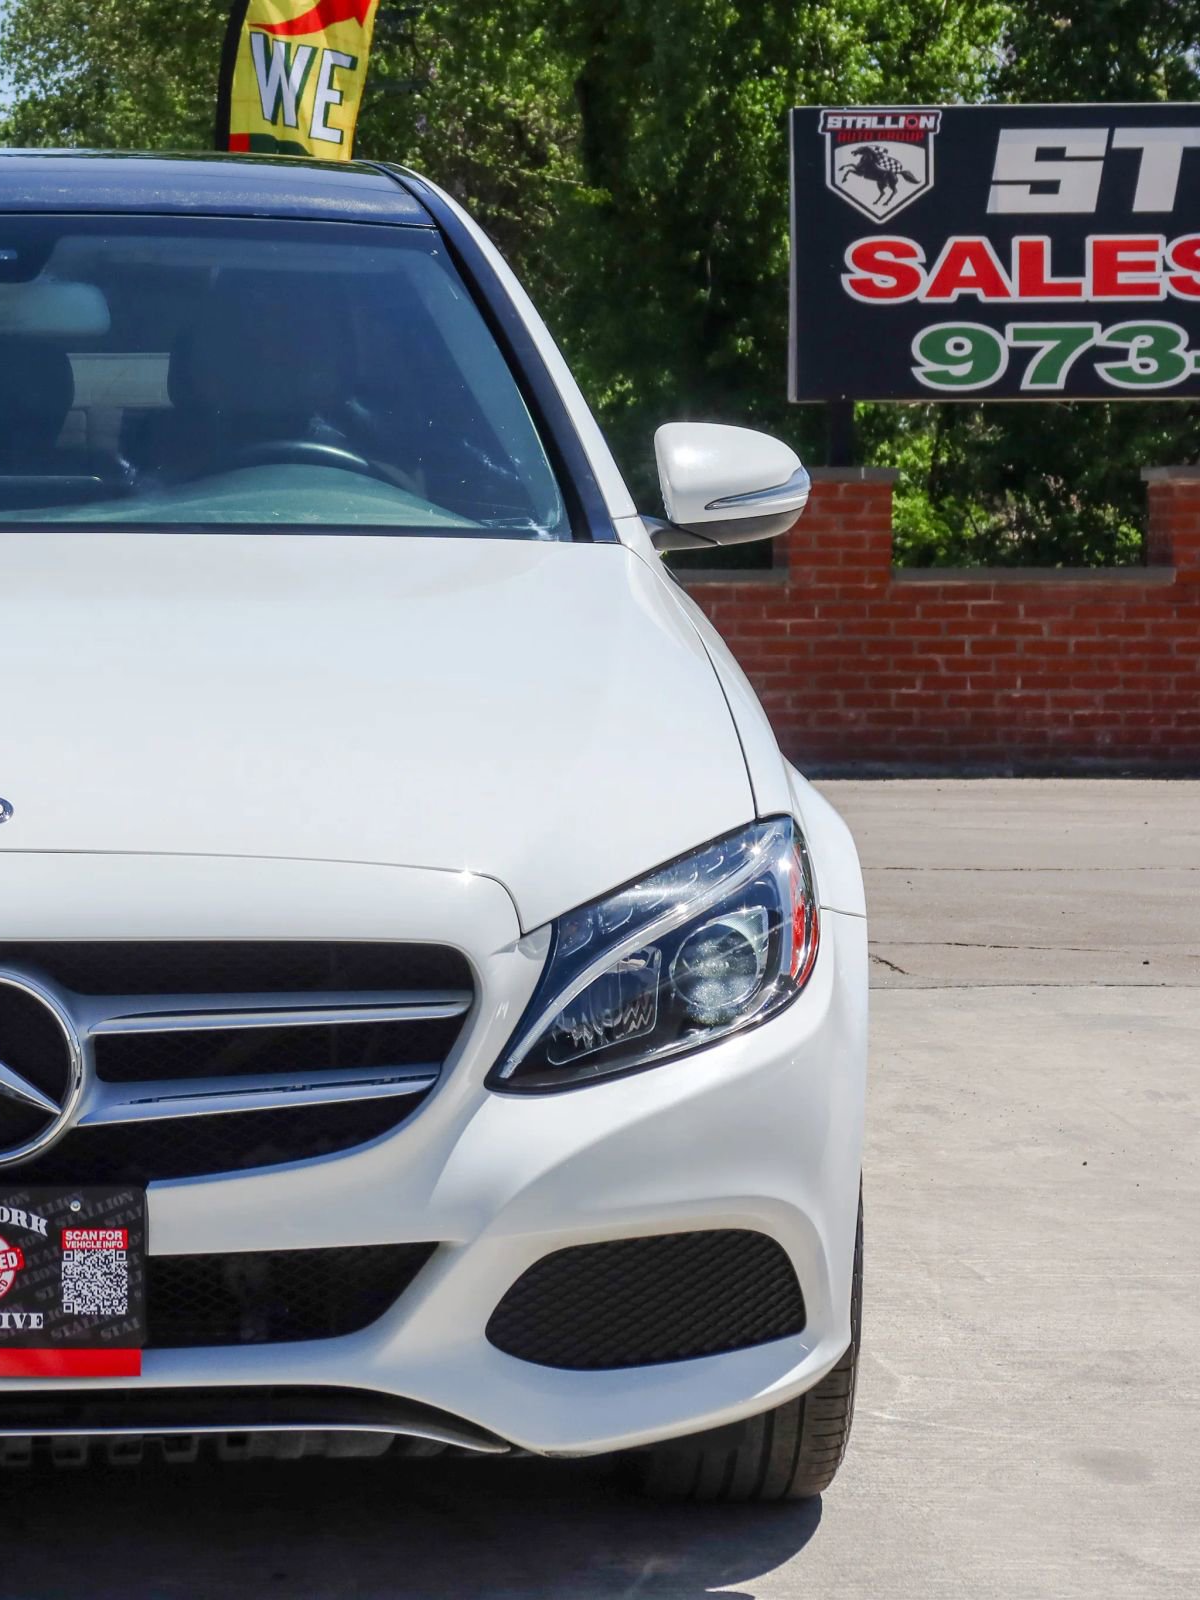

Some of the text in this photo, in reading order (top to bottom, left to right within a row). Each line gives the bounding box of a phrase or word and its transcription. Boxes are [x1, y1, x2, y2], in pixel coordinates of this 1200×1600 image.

[250, 32, 358, 145] WE
[826, 115, 936, 129] STALLION
[65, 1230, 123, 1240] SCAN FOR
[65, 1240, 124, 1248] VEHICLE INFO
